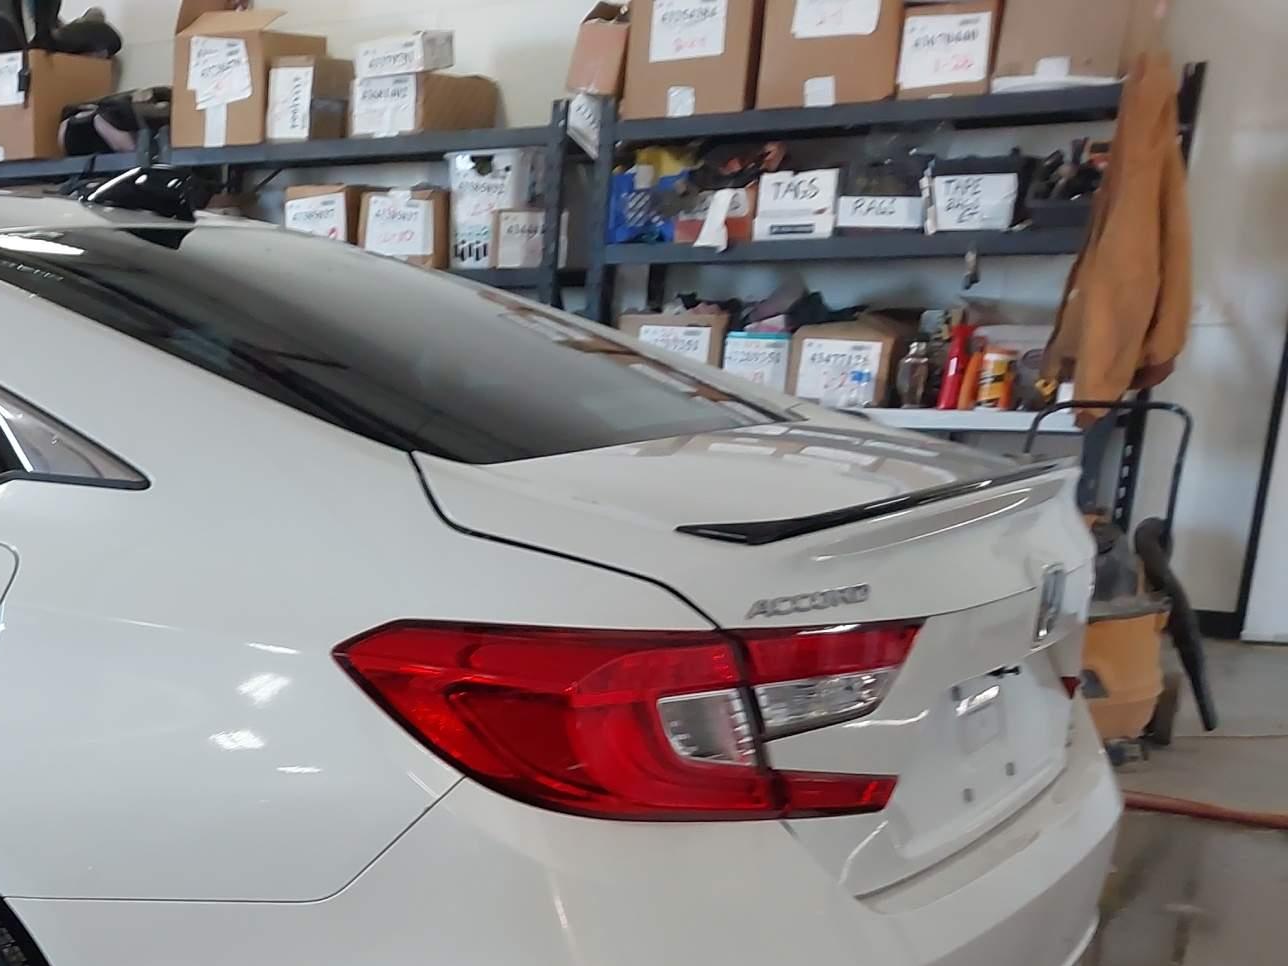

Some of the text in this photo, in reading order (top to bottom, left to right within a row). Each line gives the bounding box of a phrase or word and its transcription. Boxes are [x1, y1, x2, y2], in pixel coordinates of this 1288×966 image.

[771, 176, 821, 201] TAGS
[943, 176, 985, 196] TAPE
[850, 197, 898, 218] RAGS
[745, 582, 872, 620] ACCORD
